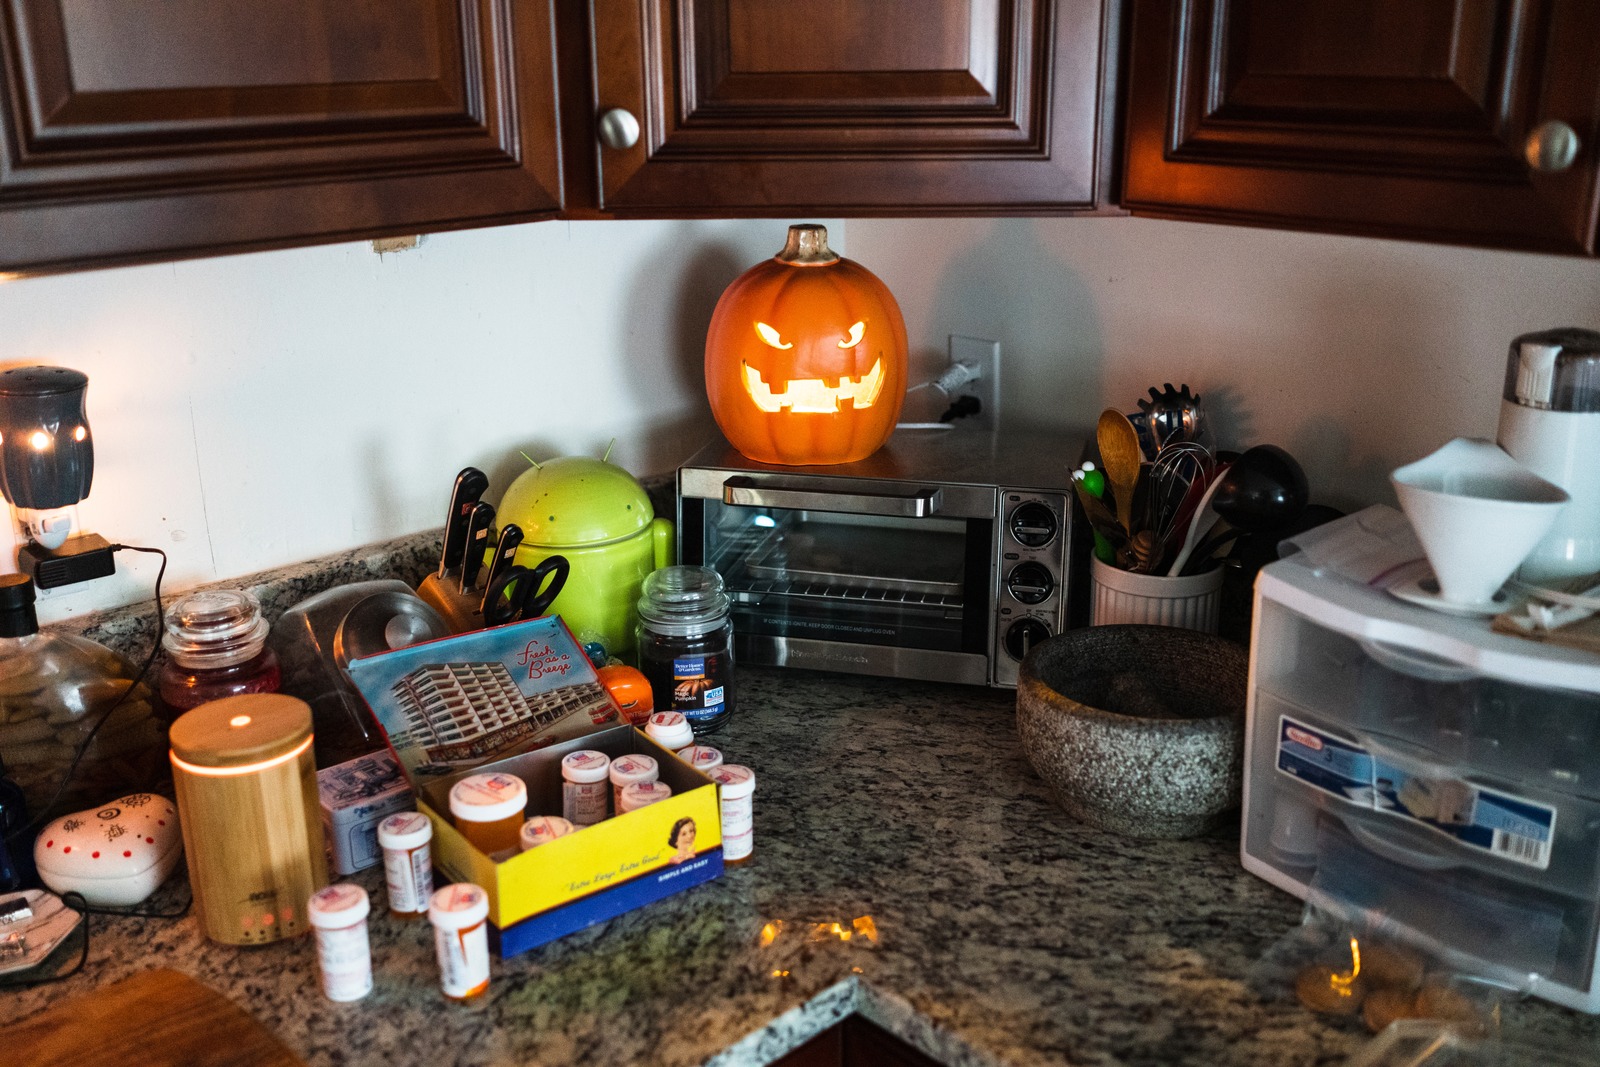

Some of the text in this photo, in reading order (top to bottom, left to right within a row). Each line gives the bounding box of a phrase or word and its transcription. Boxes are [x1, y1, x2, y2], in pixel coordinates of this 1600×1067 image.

[768, 618, 792, 626] CONTENTS
[517, 640, 555, 665] Fresh
[545, 653, 570, 663] as a
[529, 660, 571, 679] Breeze
[711, 689, 722, 697] USA
[658, 858, 709, 883] SIMPLE AND EASY
